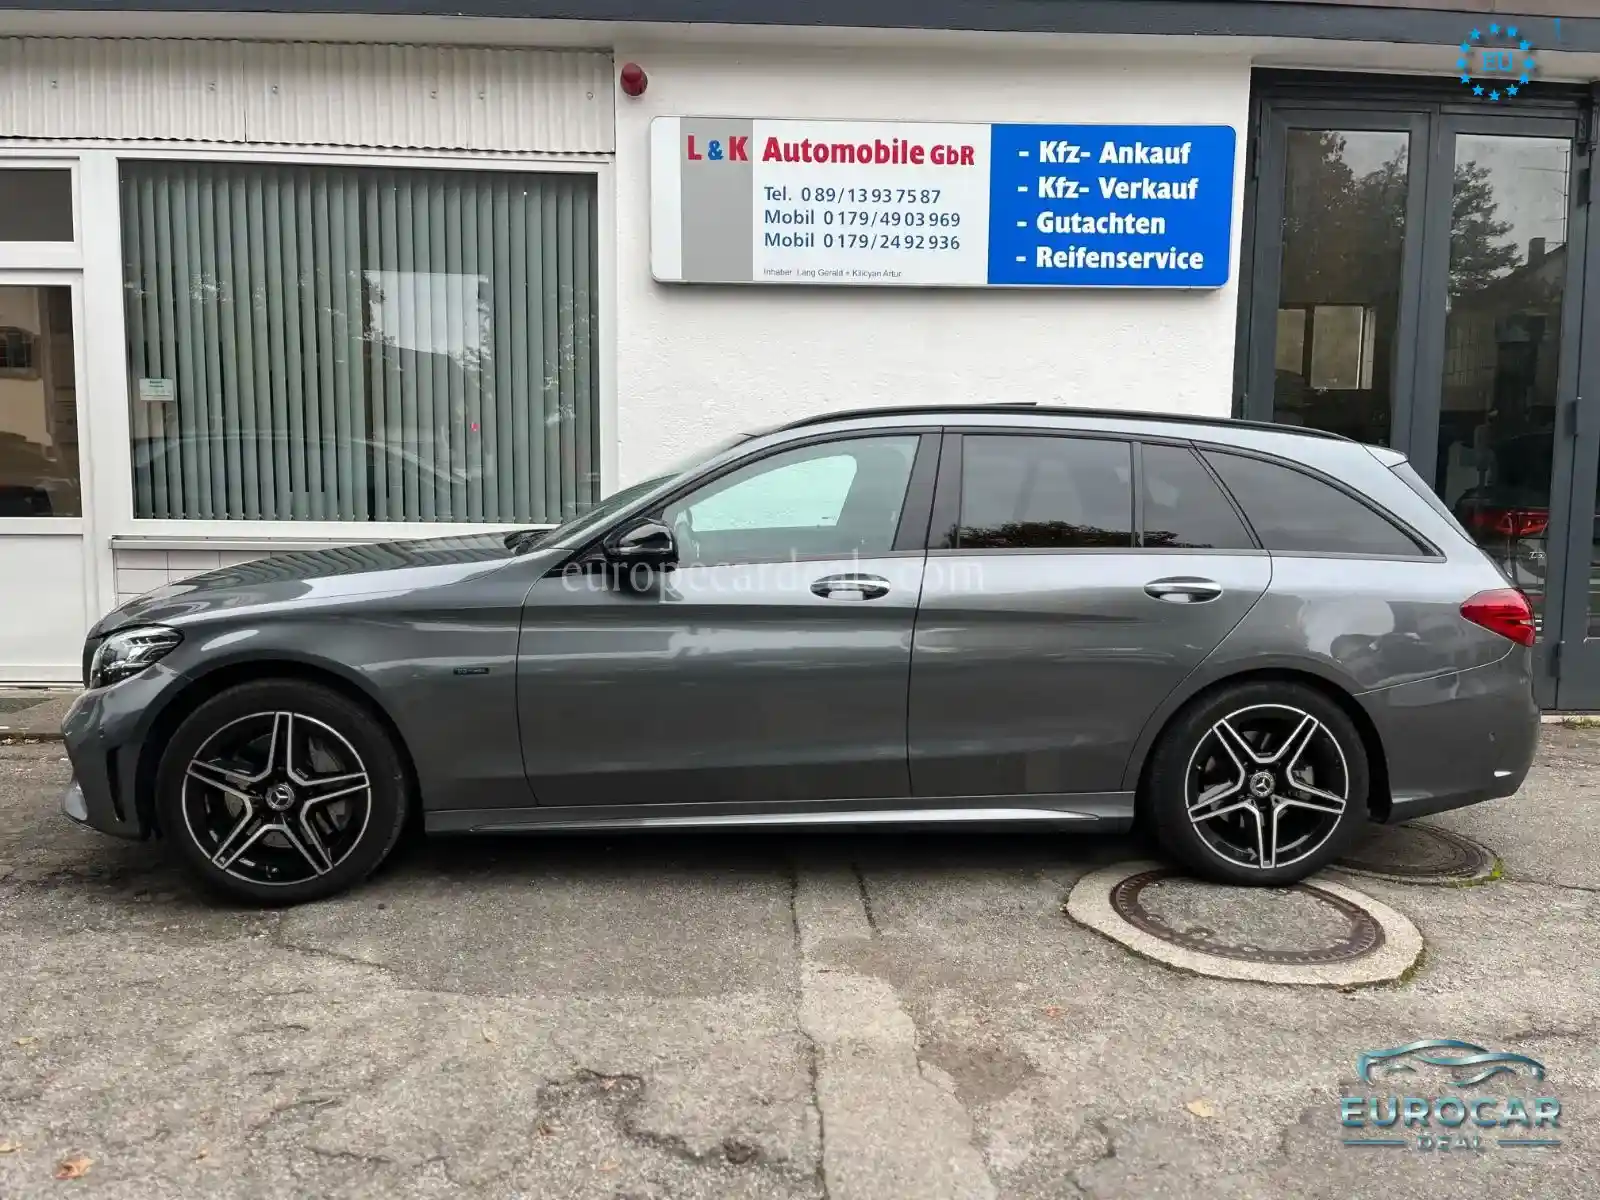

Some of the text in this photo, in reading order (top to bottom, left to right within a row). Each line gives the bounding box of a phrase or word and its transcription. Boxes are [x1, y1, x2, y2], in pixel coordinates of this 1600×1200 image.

[687, 134, 975, 166] L & K Automobile GbR
[1039, 140, 1091, 164] Kfz-
[1098, 141, 1192, 165] Ankauf
[763, 185, 792, 201] Tel.
[1038, 175, 1090, 199] Kfz-
[1098, 176, 1200, 200] Verkauf
[764, 208, 815, 225] Mobil
[1036, 210, 1166, 235] Gutachten
[764, 231, 815, 248] Mobil
[1036, 245, 1205, 270] Reifenservice
[797, 269, 816, 278] Lang
[818, 269, 844, 277] Gerald
[883, 270, 902, 278] Artur
